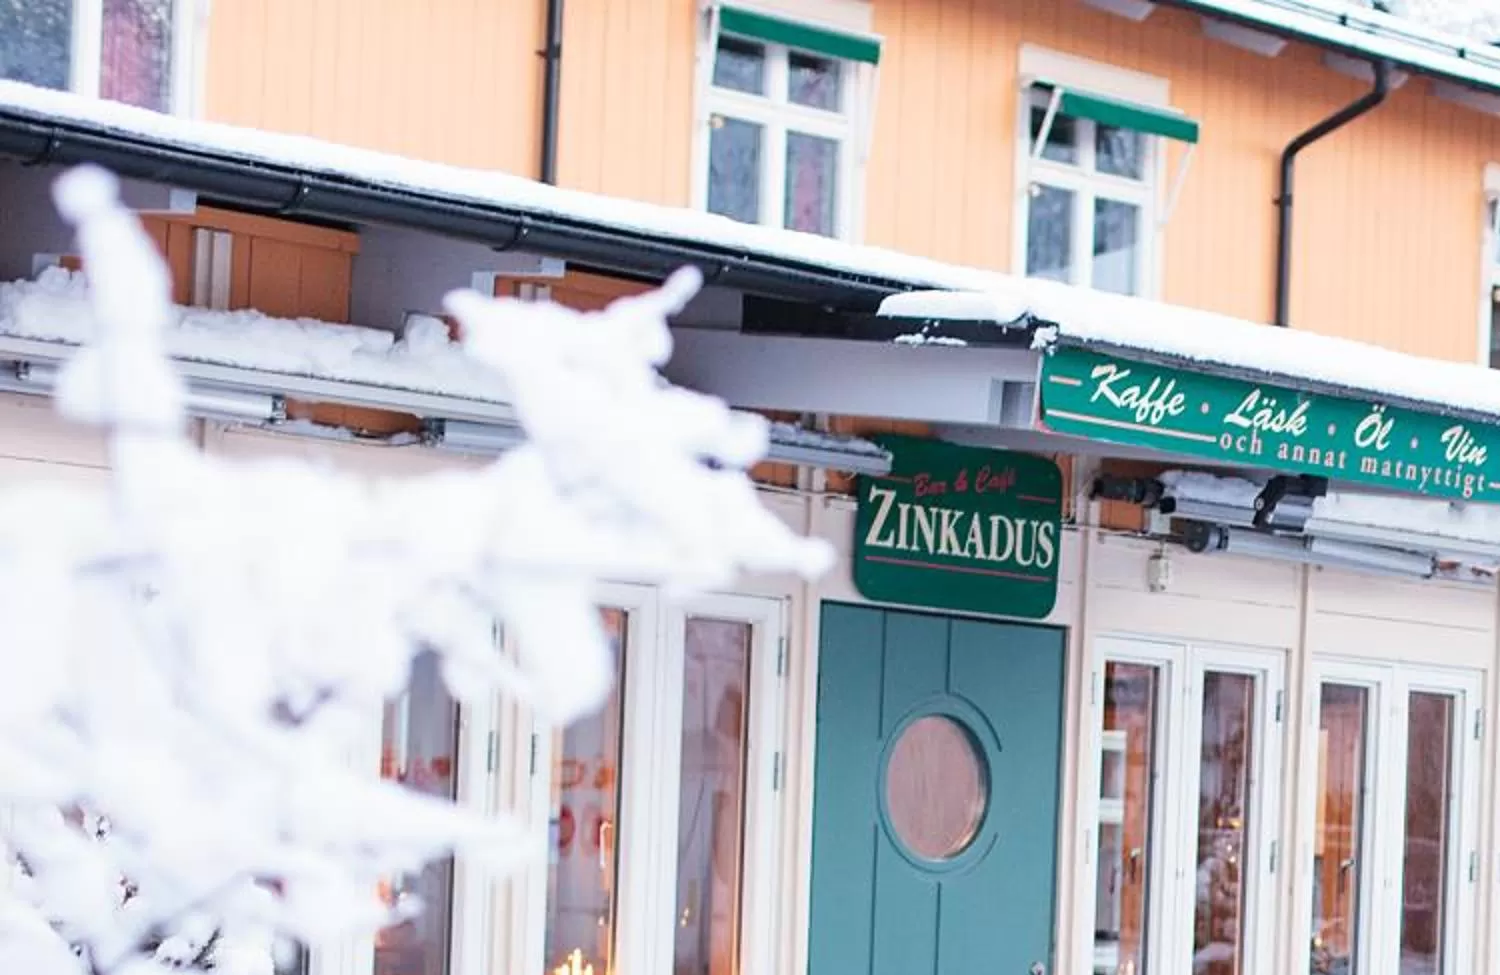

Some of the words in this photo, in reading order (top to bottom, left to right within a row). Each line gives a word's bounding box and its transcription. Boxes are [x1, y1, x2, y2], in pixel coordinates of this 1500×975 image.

[1090, 363, 1186, 425] Kaffe
[1222, 388, 1311, 437] Läsk
[1354, 404, 1395, 451] Öl
[1439, 424, 1488, 466] Vin
[1219, 425, 1263, 456] och
[1276, 441, 1347, 470] annat
[1360, 455, 1486, 499] matnyttigt
[864, 484, 1056, 569] ZINKADUS
